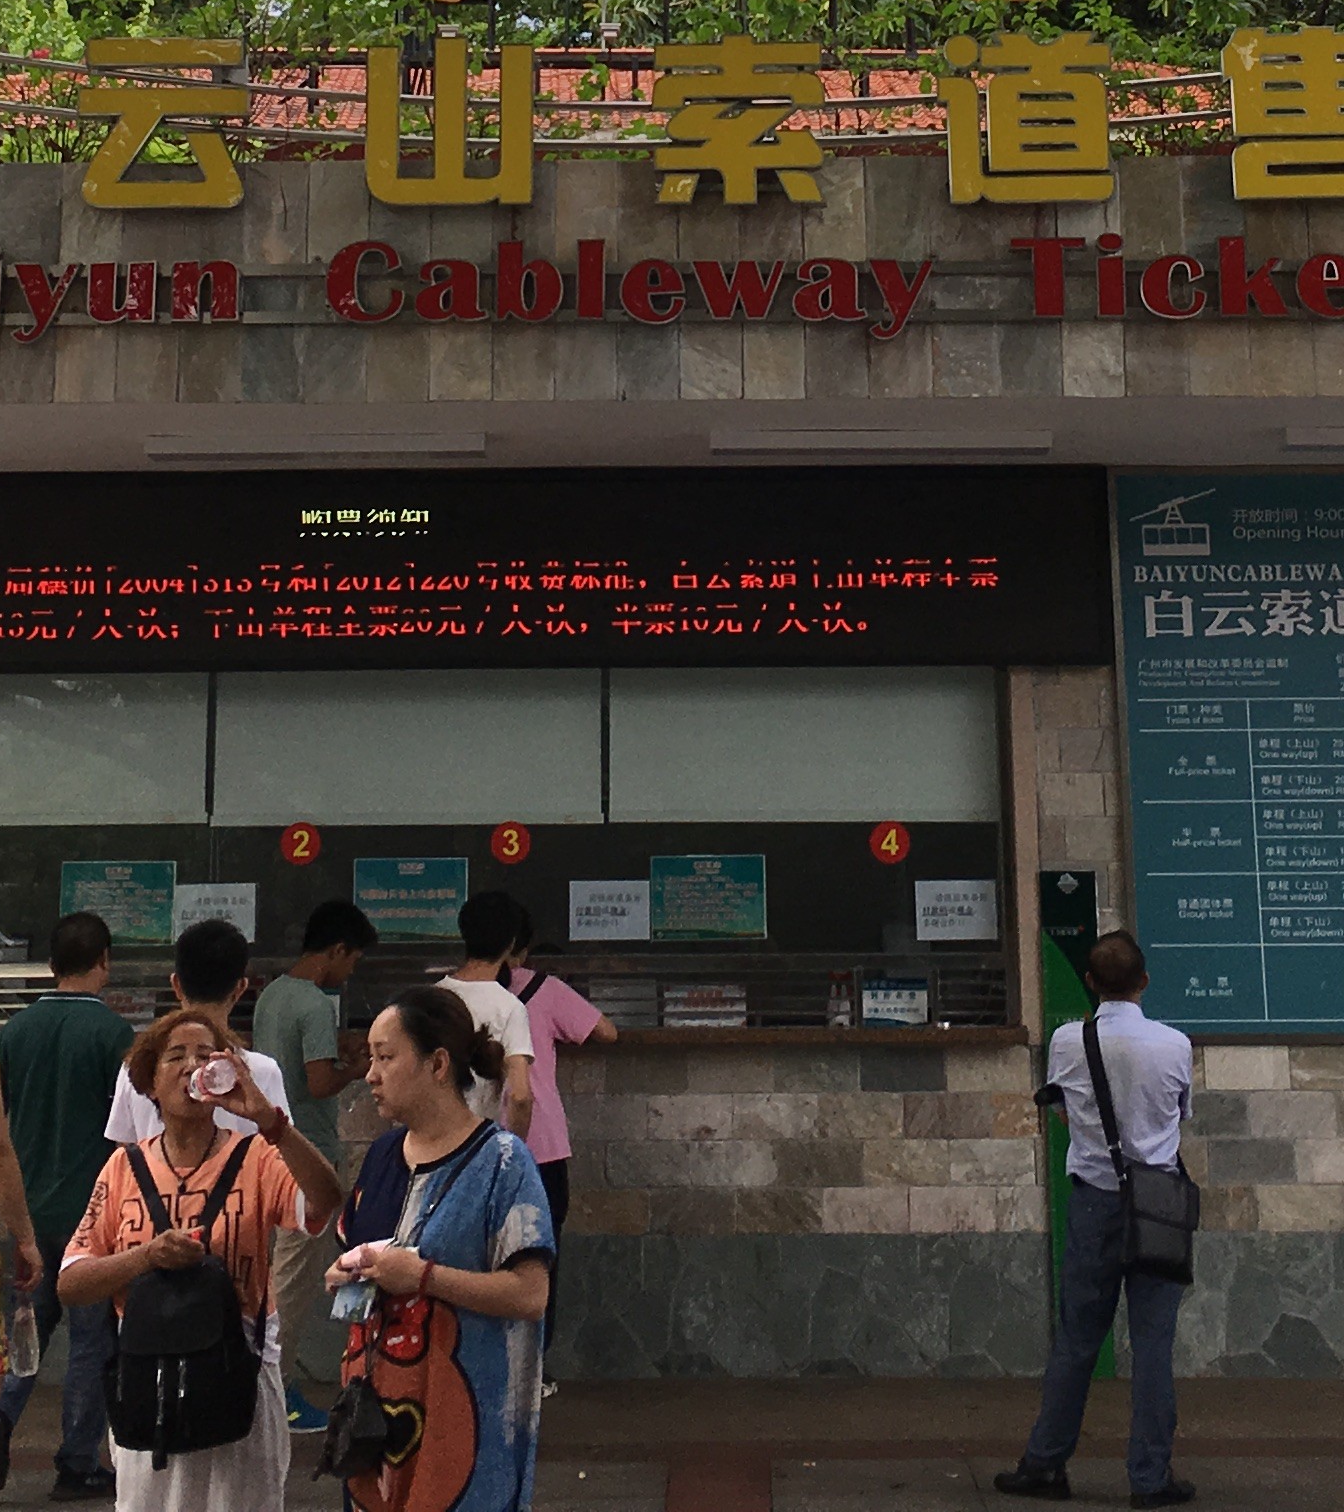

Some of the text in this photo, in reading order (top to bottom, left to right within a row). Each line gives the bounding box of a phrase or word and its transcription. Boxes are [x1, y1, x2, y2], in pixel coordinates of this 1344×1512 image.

[325, 238, 934, 340] Cableway
[1232, 524, 1301, 542] Opening
[293, 830, 311, 858] 2
[502, 829, 522, 856] 3
[880, 828, 900, 856] 4
